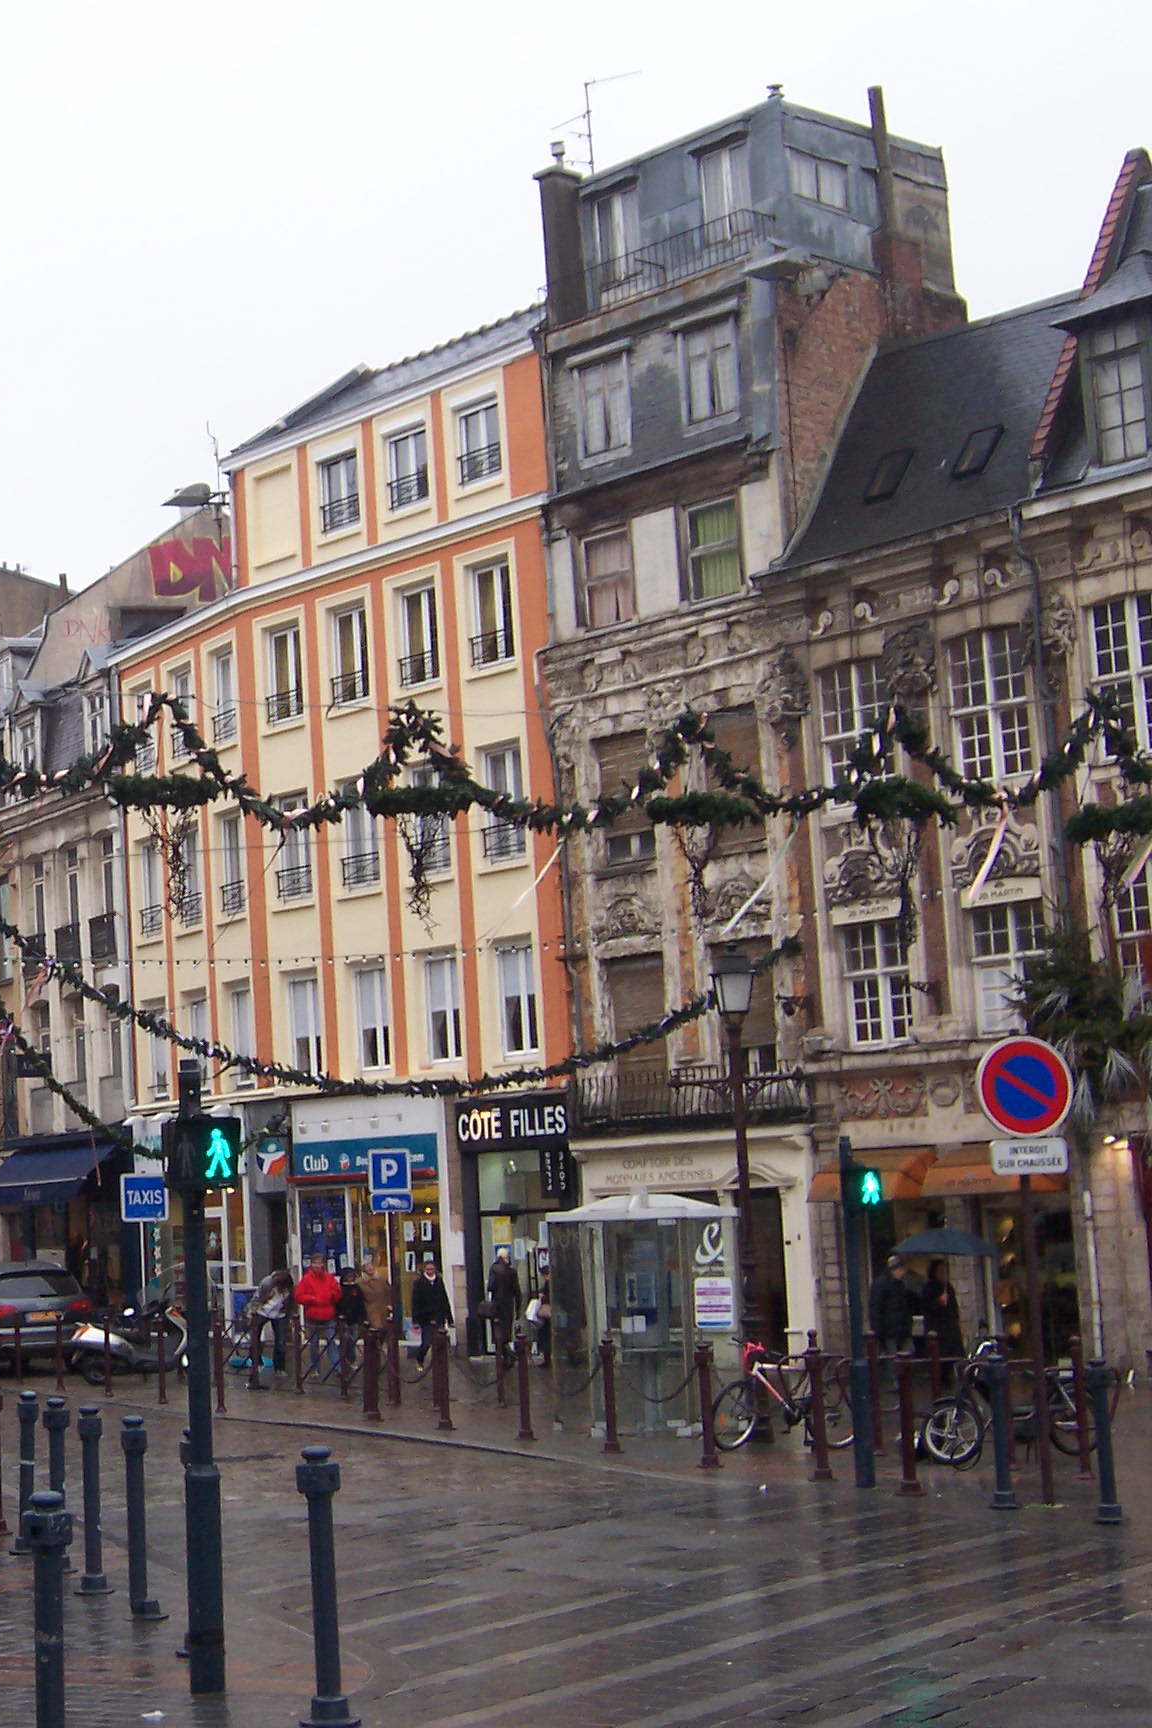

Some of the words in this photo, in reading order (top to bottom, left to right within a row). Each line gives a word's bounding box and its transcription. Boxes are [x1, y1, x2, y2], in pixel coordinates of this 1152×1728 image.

[990, 887, 1024, 898] MARTIN
[509, 1105, 567, 1138] FILLES
[1009, 1145, 1048, 1155] INTERDIT
[303, 1153, 329, 1172] Club
[622, 1157, 671, 1169] COMPTOIR
[674, 1155, 693, 1166] DES
[998, 1159, 1016, 1168] SUR
[380, 1158, 398, 1184] P
[605, 1172, 655, 1184] MONNAIES
[658, 1170, 714, 1182] ANCIENNES
[126, 1190, 163, 1205] TAXIS
